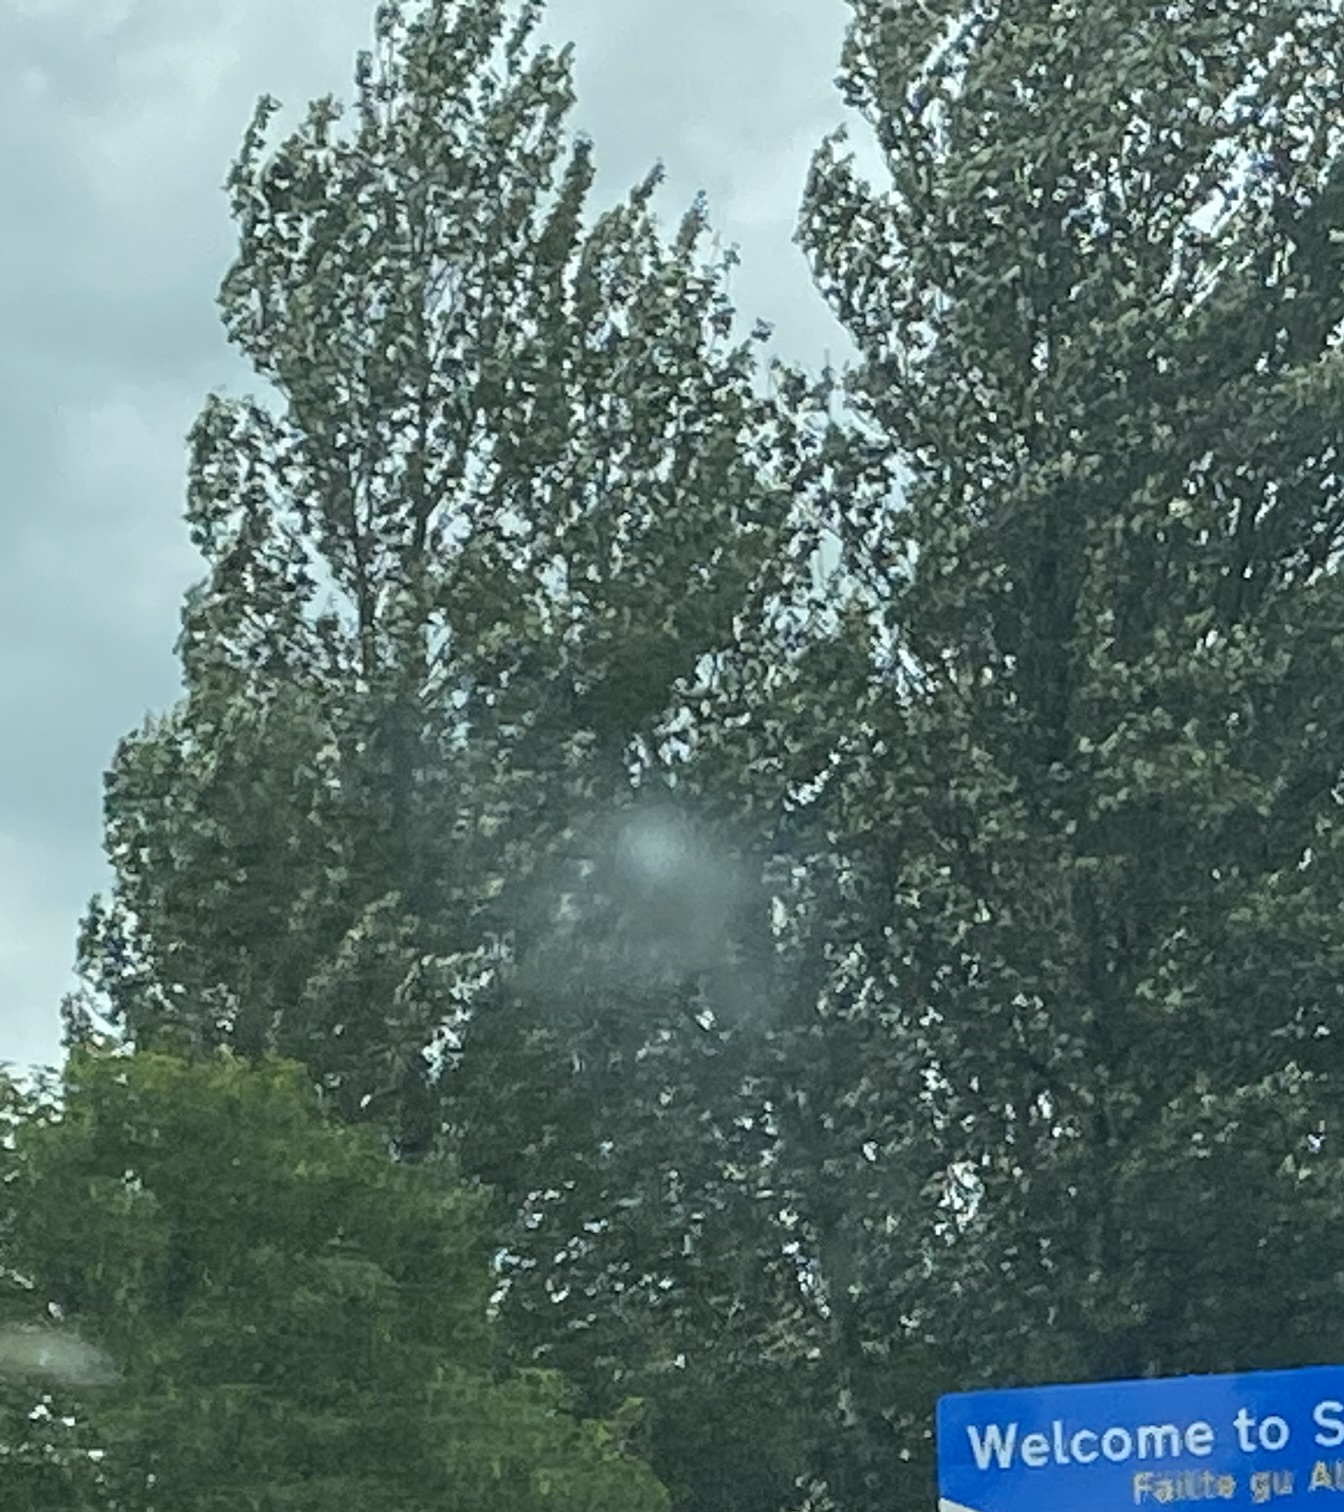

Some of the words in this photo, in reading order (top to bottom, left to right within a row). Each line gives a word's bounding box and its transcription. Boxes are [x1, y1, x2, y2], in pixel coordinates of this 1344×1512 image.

[967, 1420, 1214, 1470] Welcome
[1233, 1407, 1290, 1453] to
[1250, 1470, 1294, 1503] gu
